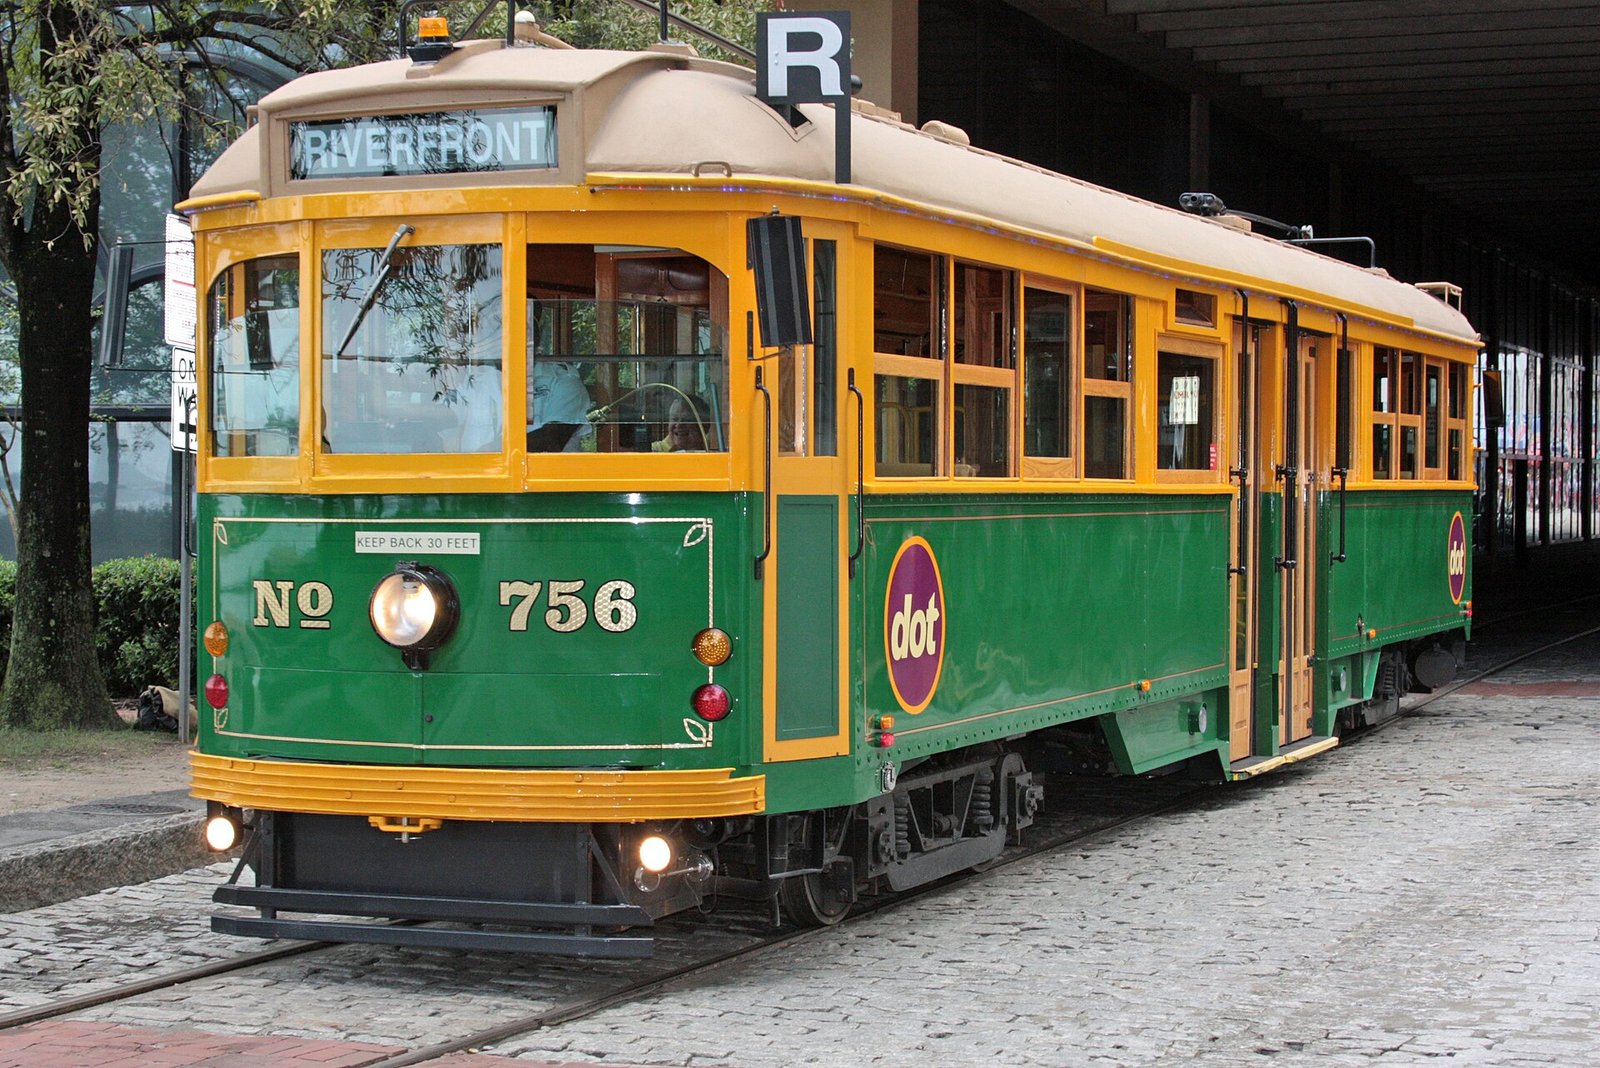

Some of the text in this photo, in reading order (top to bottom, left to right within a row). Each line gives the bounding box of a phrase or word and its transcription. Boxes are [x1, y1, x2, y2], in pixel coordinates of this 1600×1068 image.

[767, 17, 845, 97] R
[303, 119, 546, 170] RIVERFRONT
[178, 357, 197, 381] ON
[356, 536, 478, 549] KEEP BACK 30 FEET
[1450, 541, 1463, 575] dot
[498, 578, 638, 634] 756
[891, 592, 939, 661] dot
